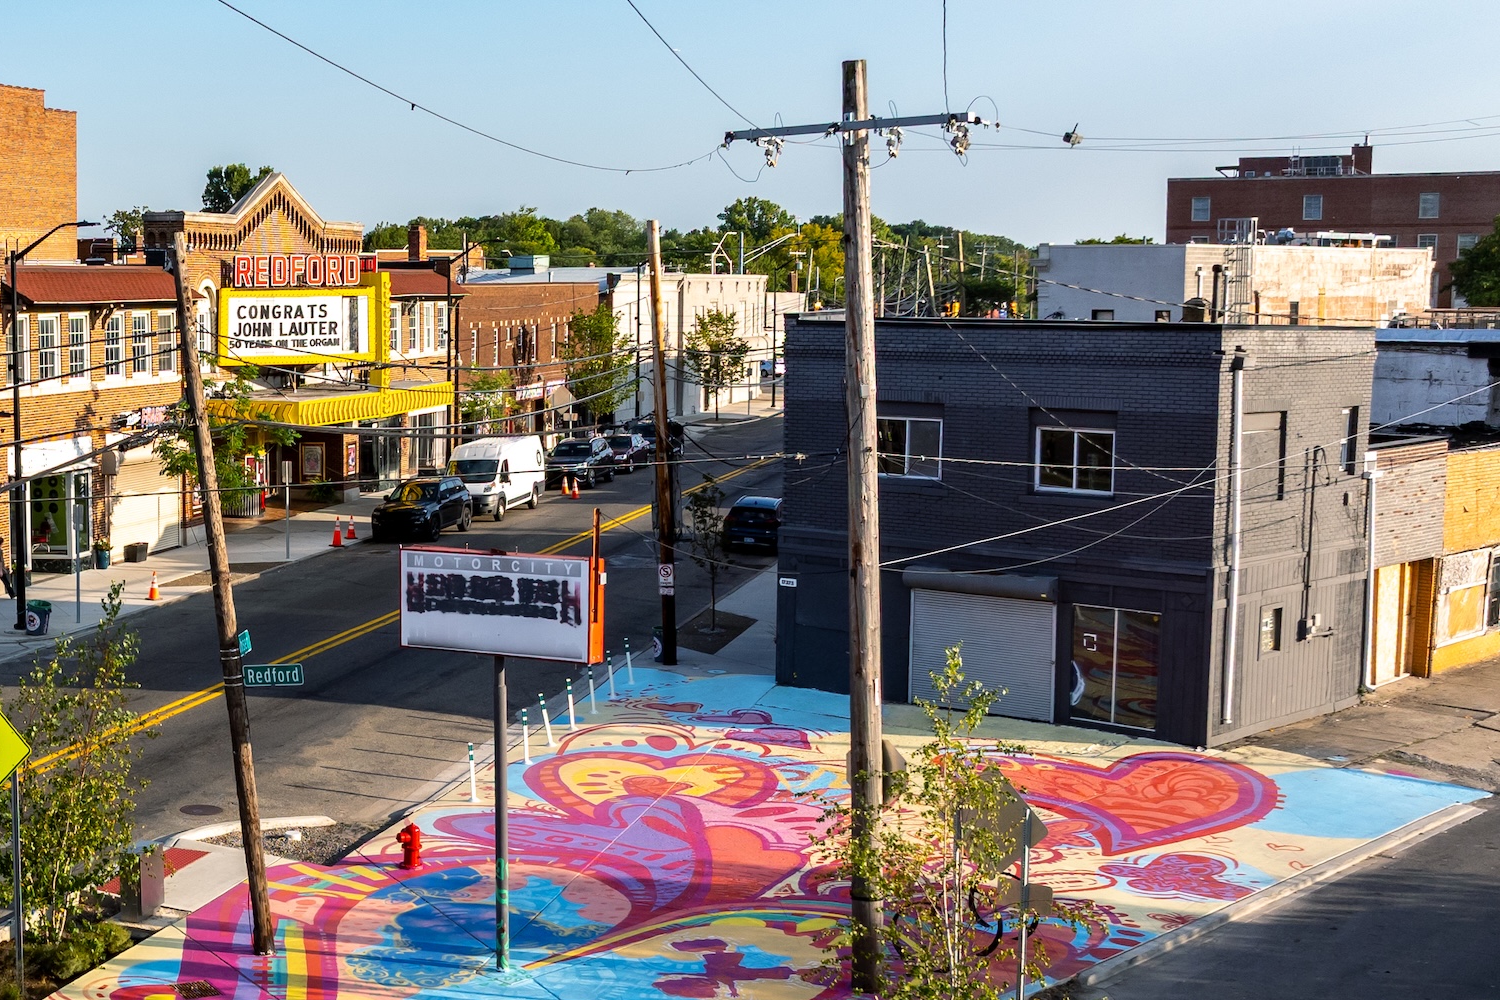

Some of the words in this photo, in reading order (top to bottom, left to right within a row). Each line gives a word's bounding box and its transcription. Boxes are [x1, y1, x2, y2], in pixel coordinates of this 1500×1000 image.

[234, 254, 361, 287] REDFORD
[237, 304, 327, 319] CONGRATS
[233, 322, 271, 337] JOHN
[280, 321, 338, 336] LAUTER
[229, 340, 241, 349] 50
[244, 339, 273, 349] YEARS
[275, 339, 288, 348] ON
[291, 338, 308, 348] THE
[309, 337, 340, 347] ORGAN
[247, 667, 300, 683] Redford
